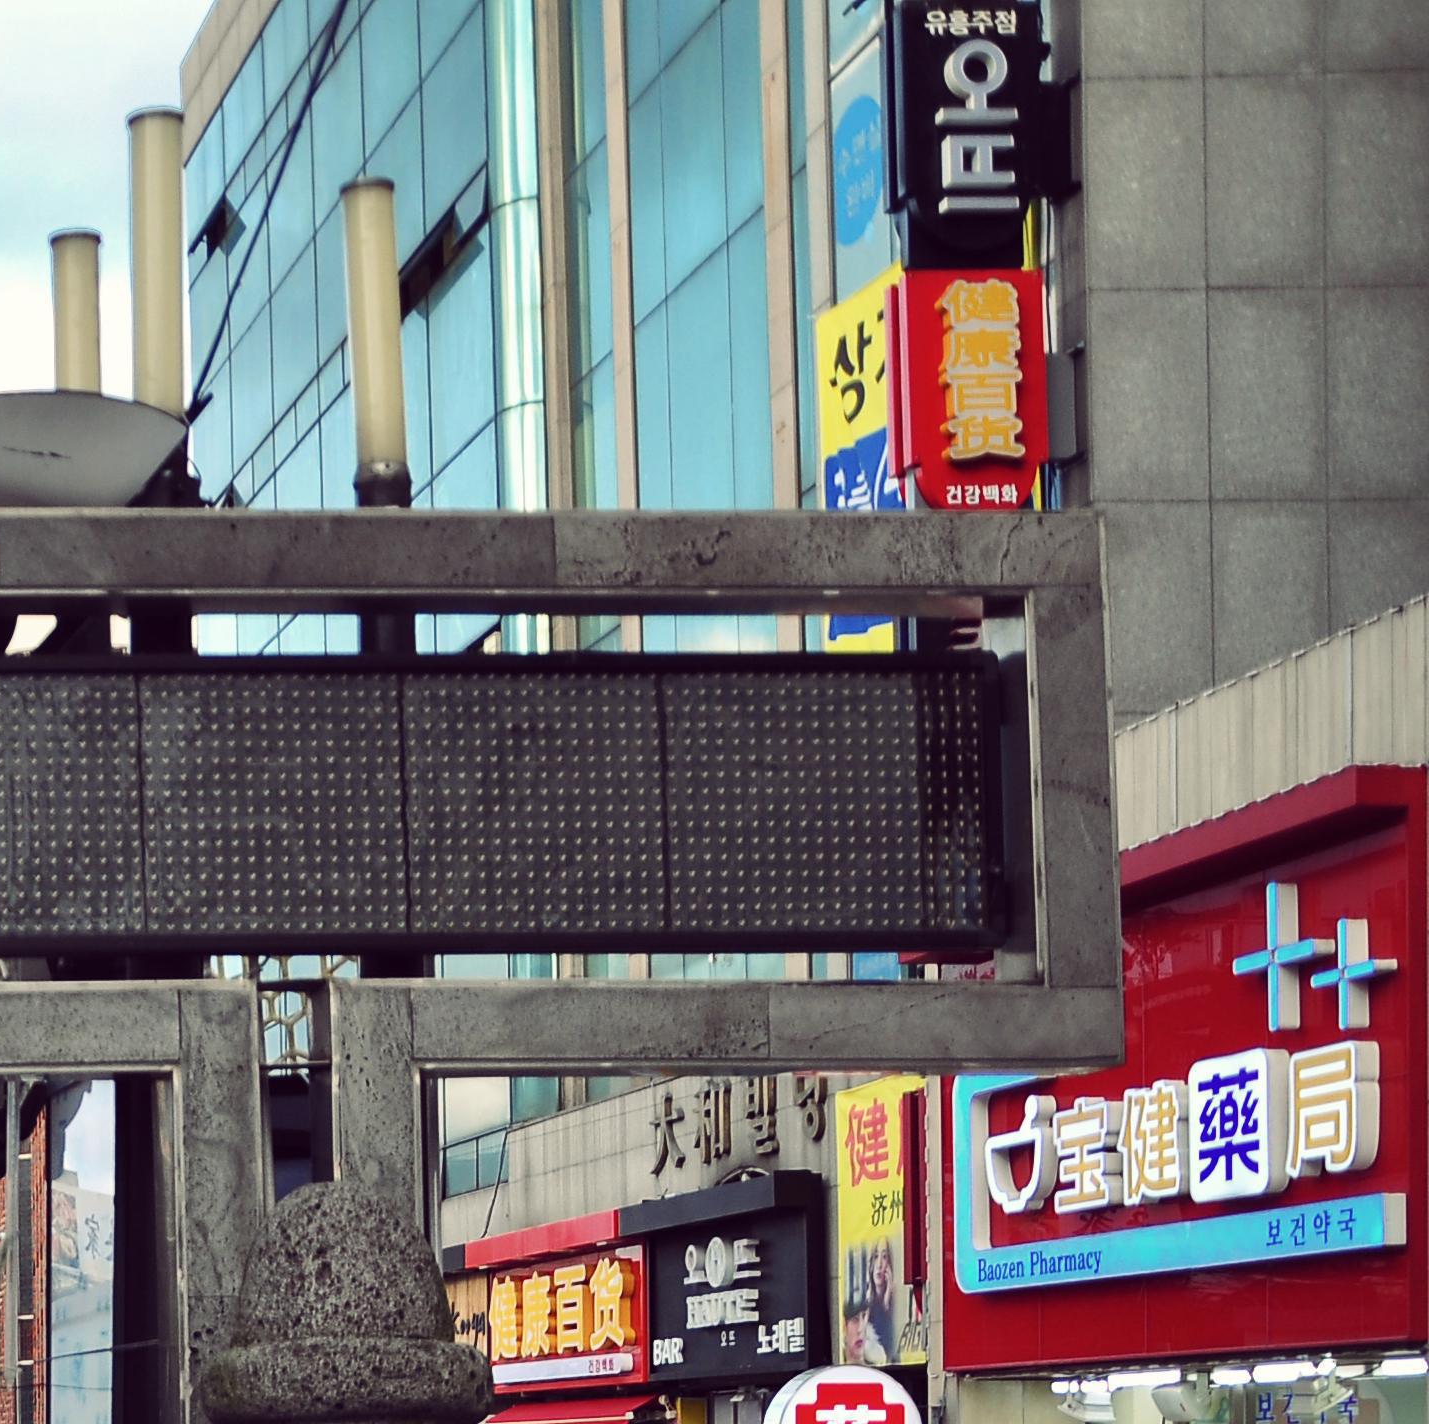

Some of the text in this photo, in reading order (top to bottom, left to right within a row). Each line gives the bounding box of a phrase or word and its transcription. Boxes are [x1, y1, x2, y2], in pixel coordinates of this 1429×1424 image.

[924, 9, 1017, 37] 유흥주점
[945, 483, 1018, 506] 건강백화
[844, 1097, 904, 1189] 健
[1052, 1040, 1363, 1215] 宝健藥局
[1265, 1206, 1358, 1248] 보건약국
[977, 1247, 1103, 1283] Baozen Pharmacy
[488, 1256, 633, 1362] 健康百货
[652, 1337, 685, 1367] BAR
[756, 1316, 806, 1354] 노래텔
